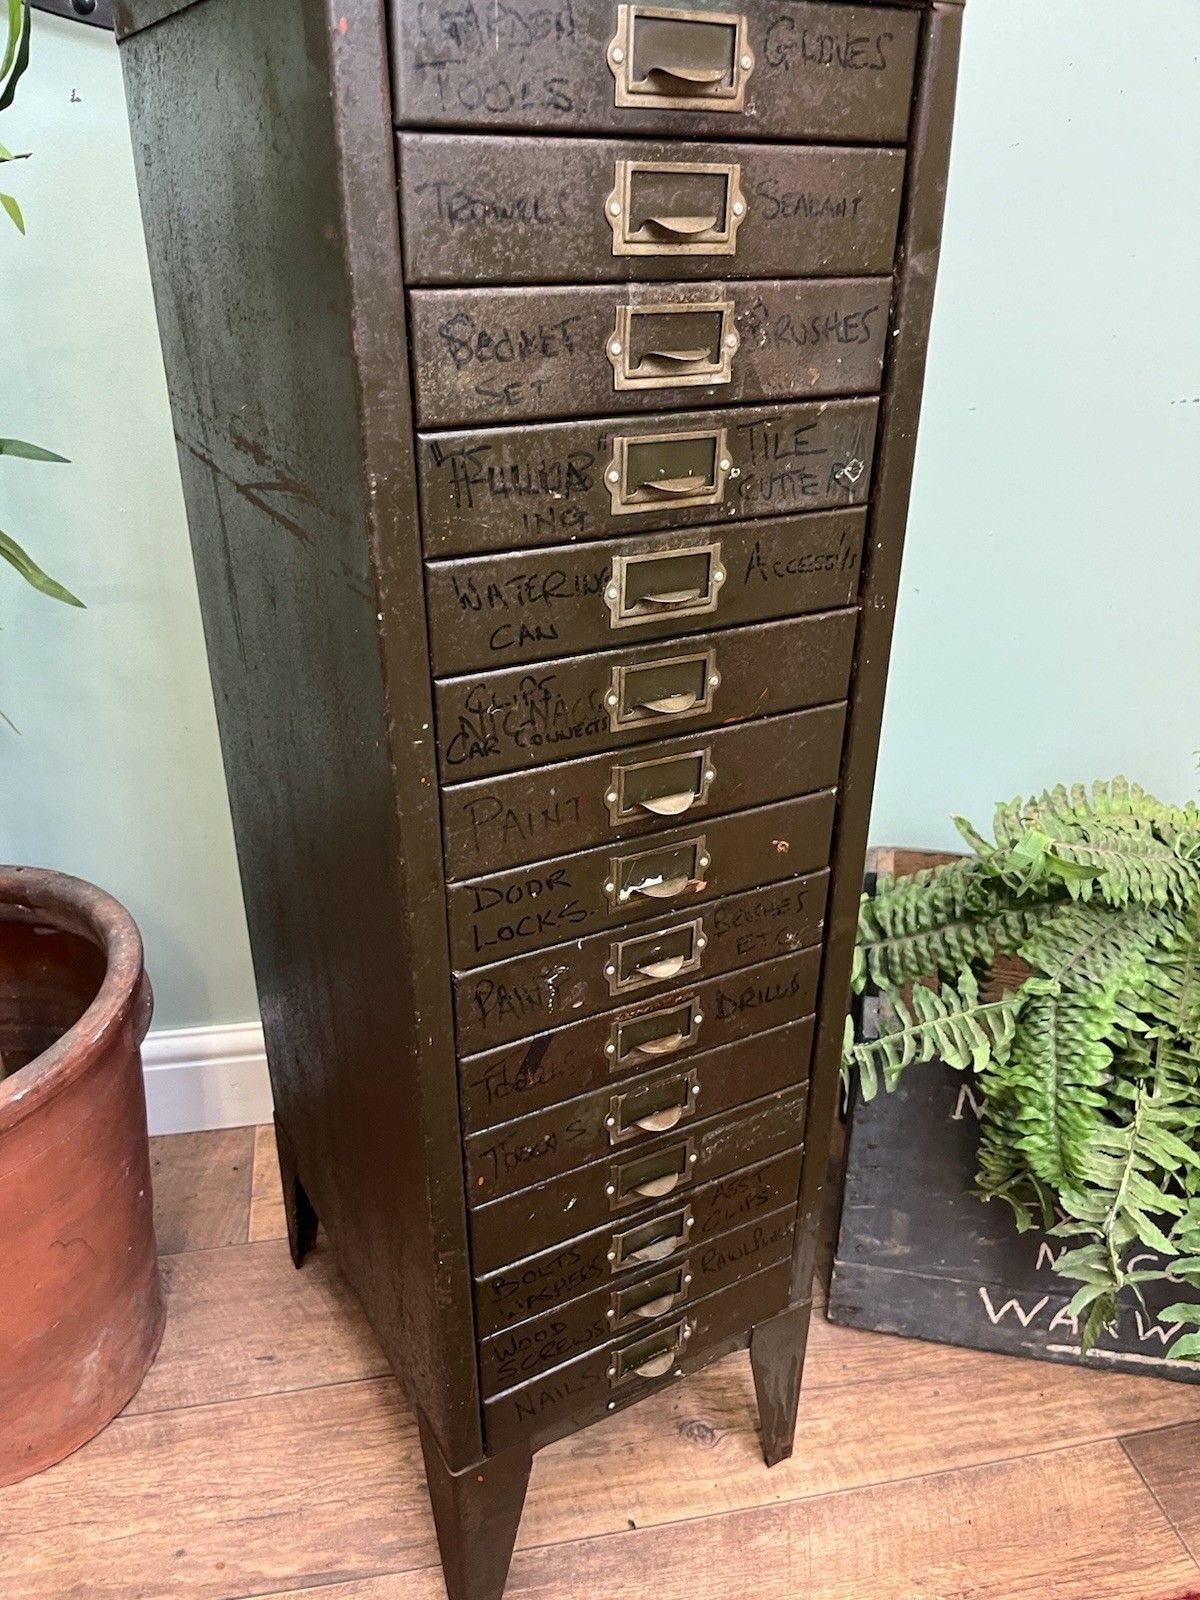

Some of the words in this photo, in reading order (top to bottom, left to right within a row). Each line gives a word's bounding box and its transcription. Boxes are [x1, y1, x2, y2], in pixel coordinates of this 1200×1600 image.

[763, 15, 894, 71] GLOVES
[756, 178, 864, 221] SEALANT
[738, 297, 880, 347] BRUSHES
[475, 373, 552, 405] SET
[736, 416, 828, 467] TILE
[521, 504, 589, 534] ING
[489, 623, 559, 651] CAN
[446, 731, 502, 765] CAR
[463, 795, 583, 852] PAINT
[464, 868, 572, 915] DOOR
[715, 971, 801, 1021] DRILLS
[491, 1247, 581, 1304] BOLTS
[493, 1321, 568, 1360] WOOD
[514, 1373, 602, 1422] NAILS
